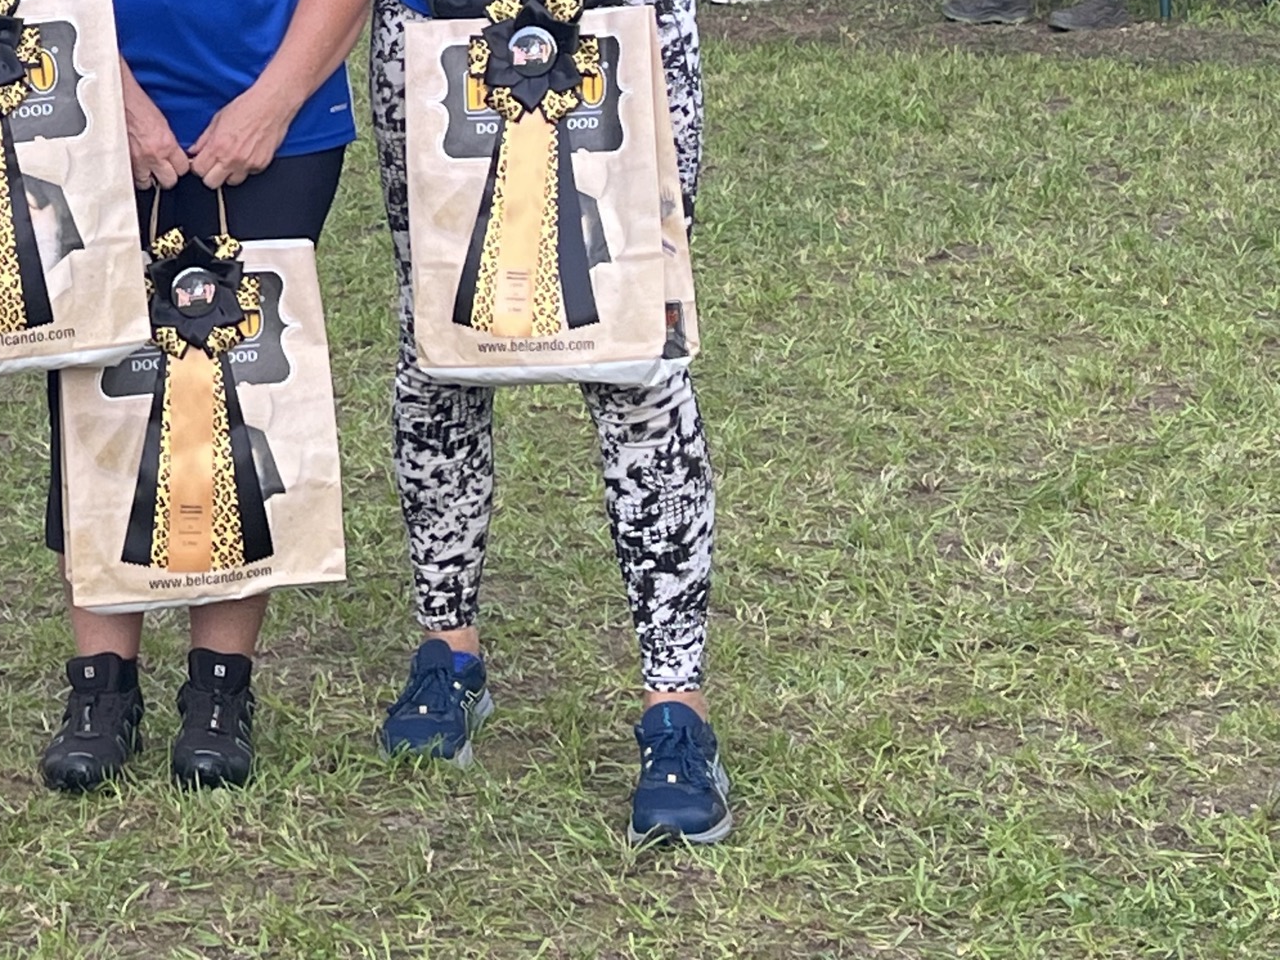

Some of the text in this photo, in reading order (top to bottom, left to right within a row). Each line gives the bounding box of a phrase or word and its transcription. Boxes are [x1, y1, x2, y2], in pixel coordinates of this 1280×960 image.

[477, 116, 599, 135] DO OOD
[478, 339, 595, 353] www.belcando.com
[228, 349, 258, 364] OOD
[149, 565, 272, 589] www.belcando.com
